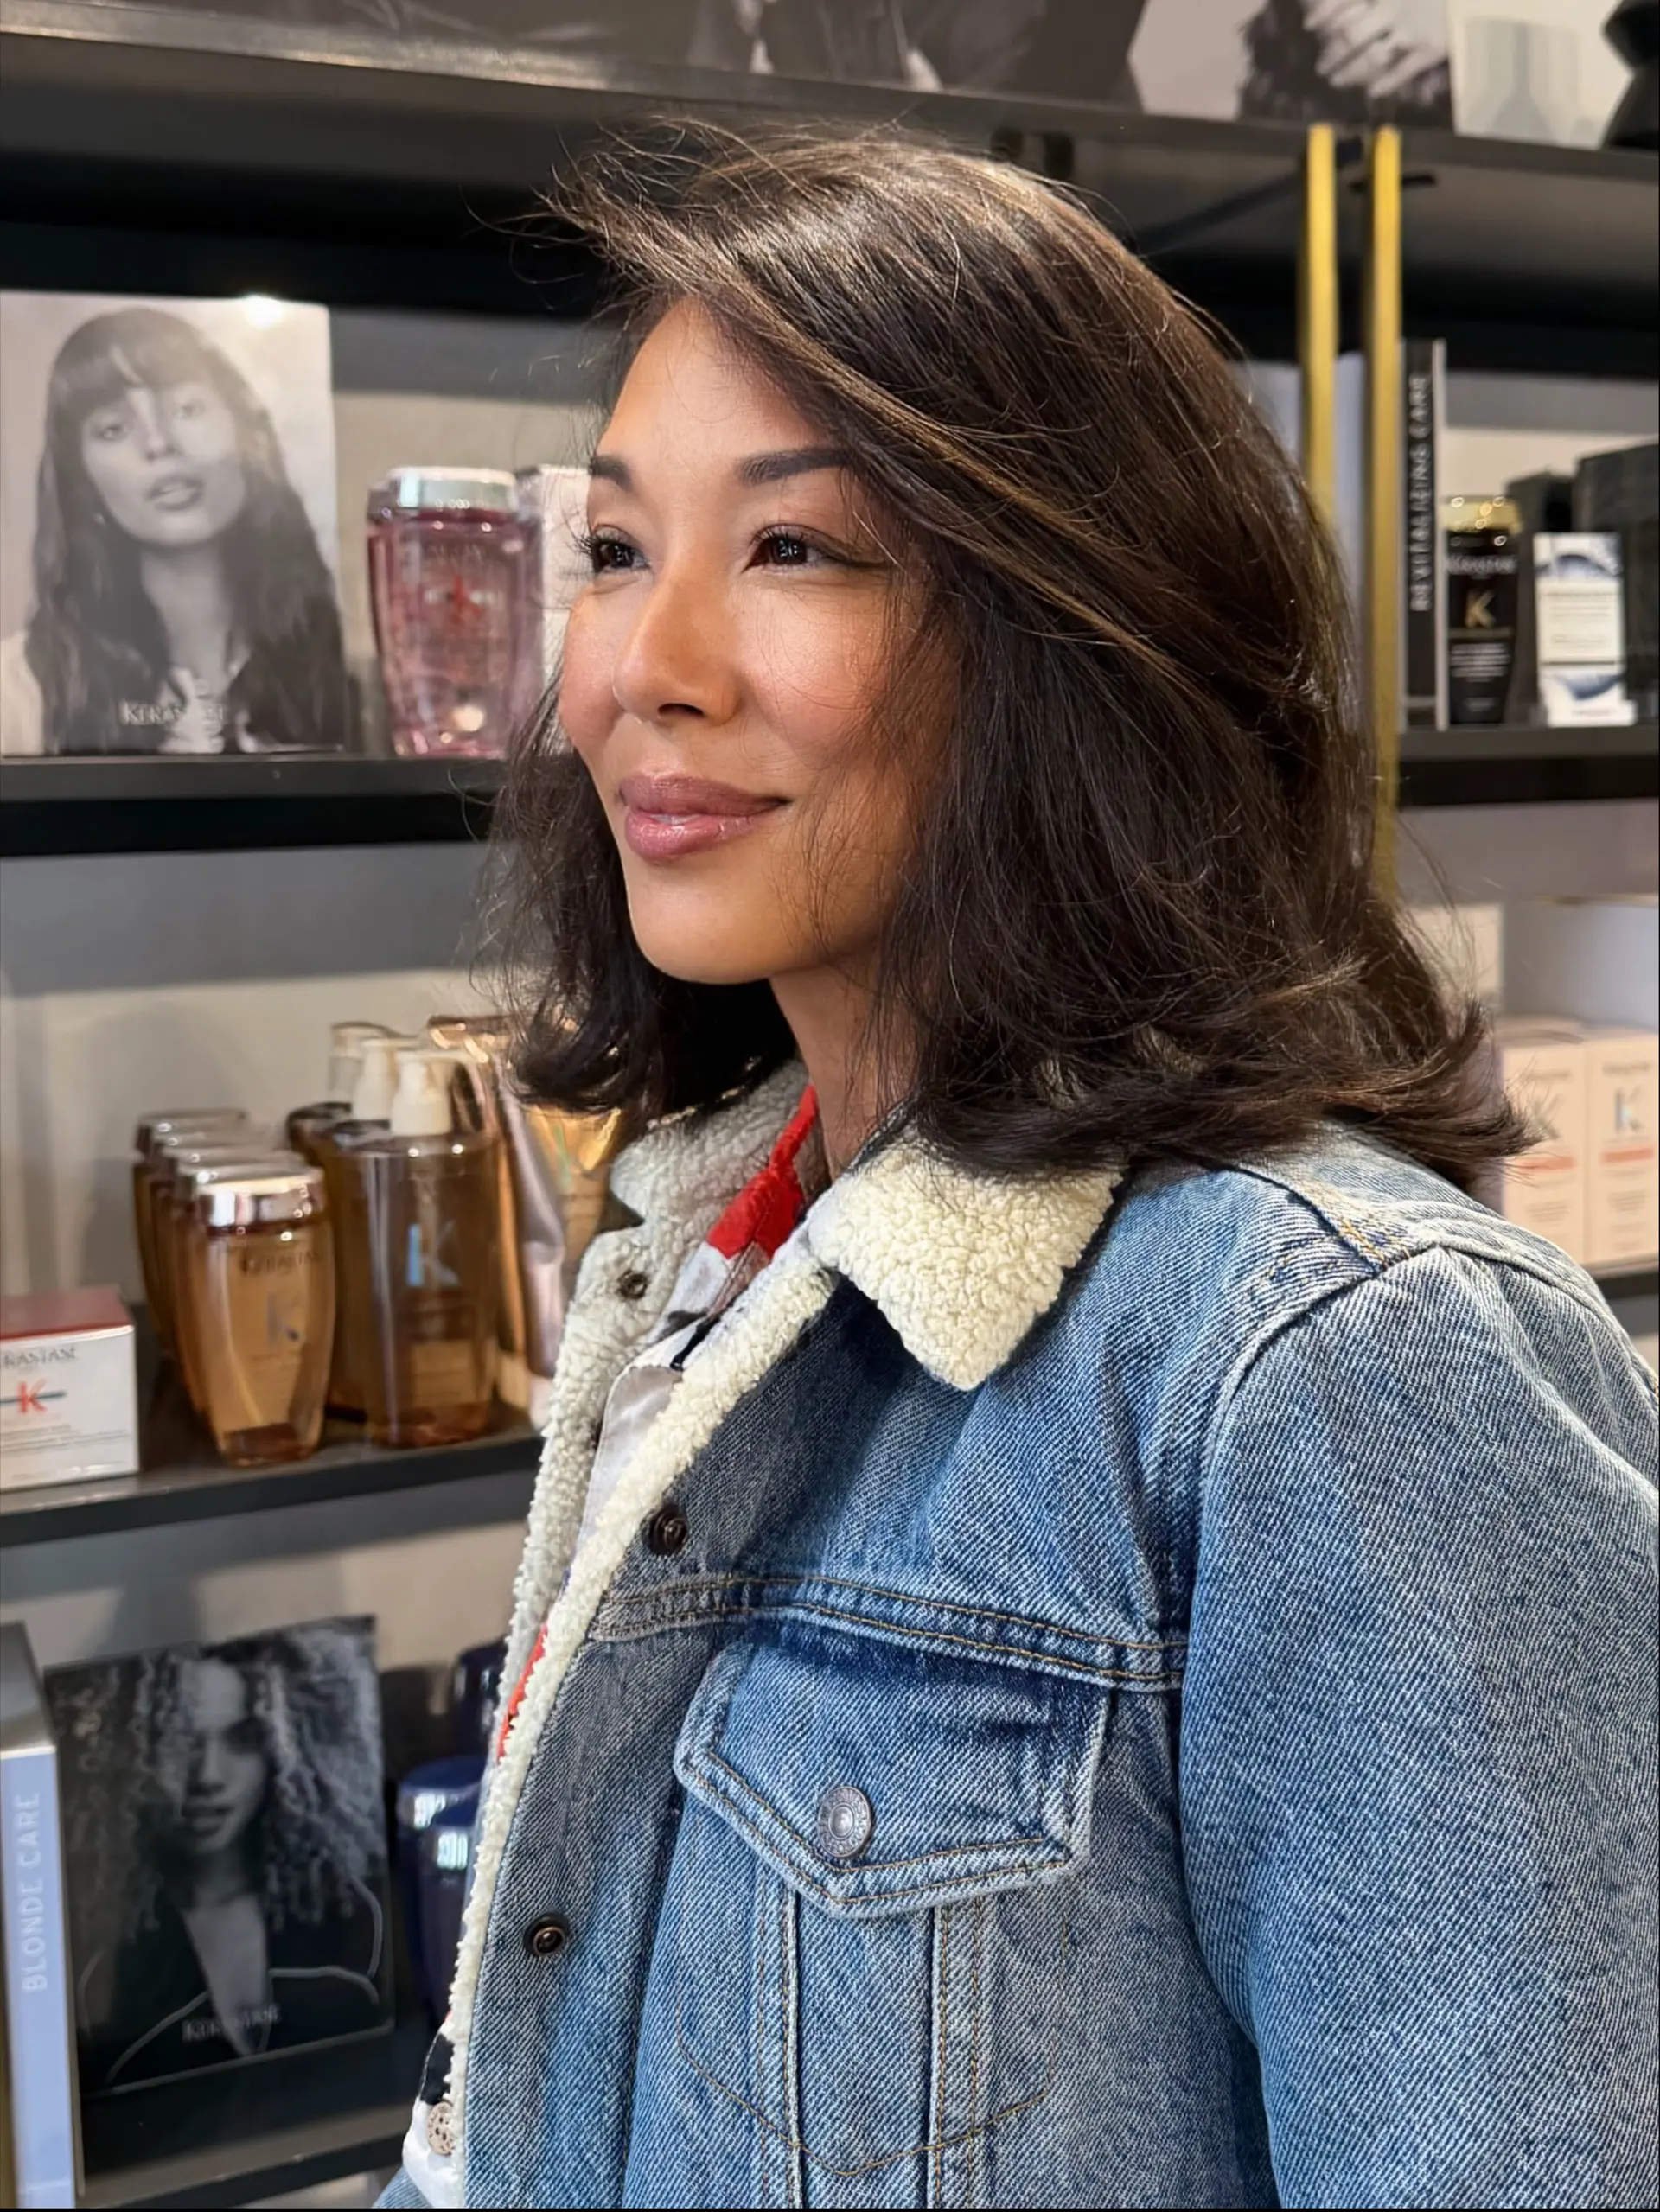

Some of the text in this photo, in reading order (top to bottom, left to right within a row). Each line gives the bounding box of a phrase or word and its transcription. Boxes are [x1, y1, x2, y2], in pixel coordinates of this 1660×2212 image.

[1465, 589, 1497, 628] K
[17, 1379, 47, 1415] K
[14, 1792, 48, 1992] BLONDE CARE
